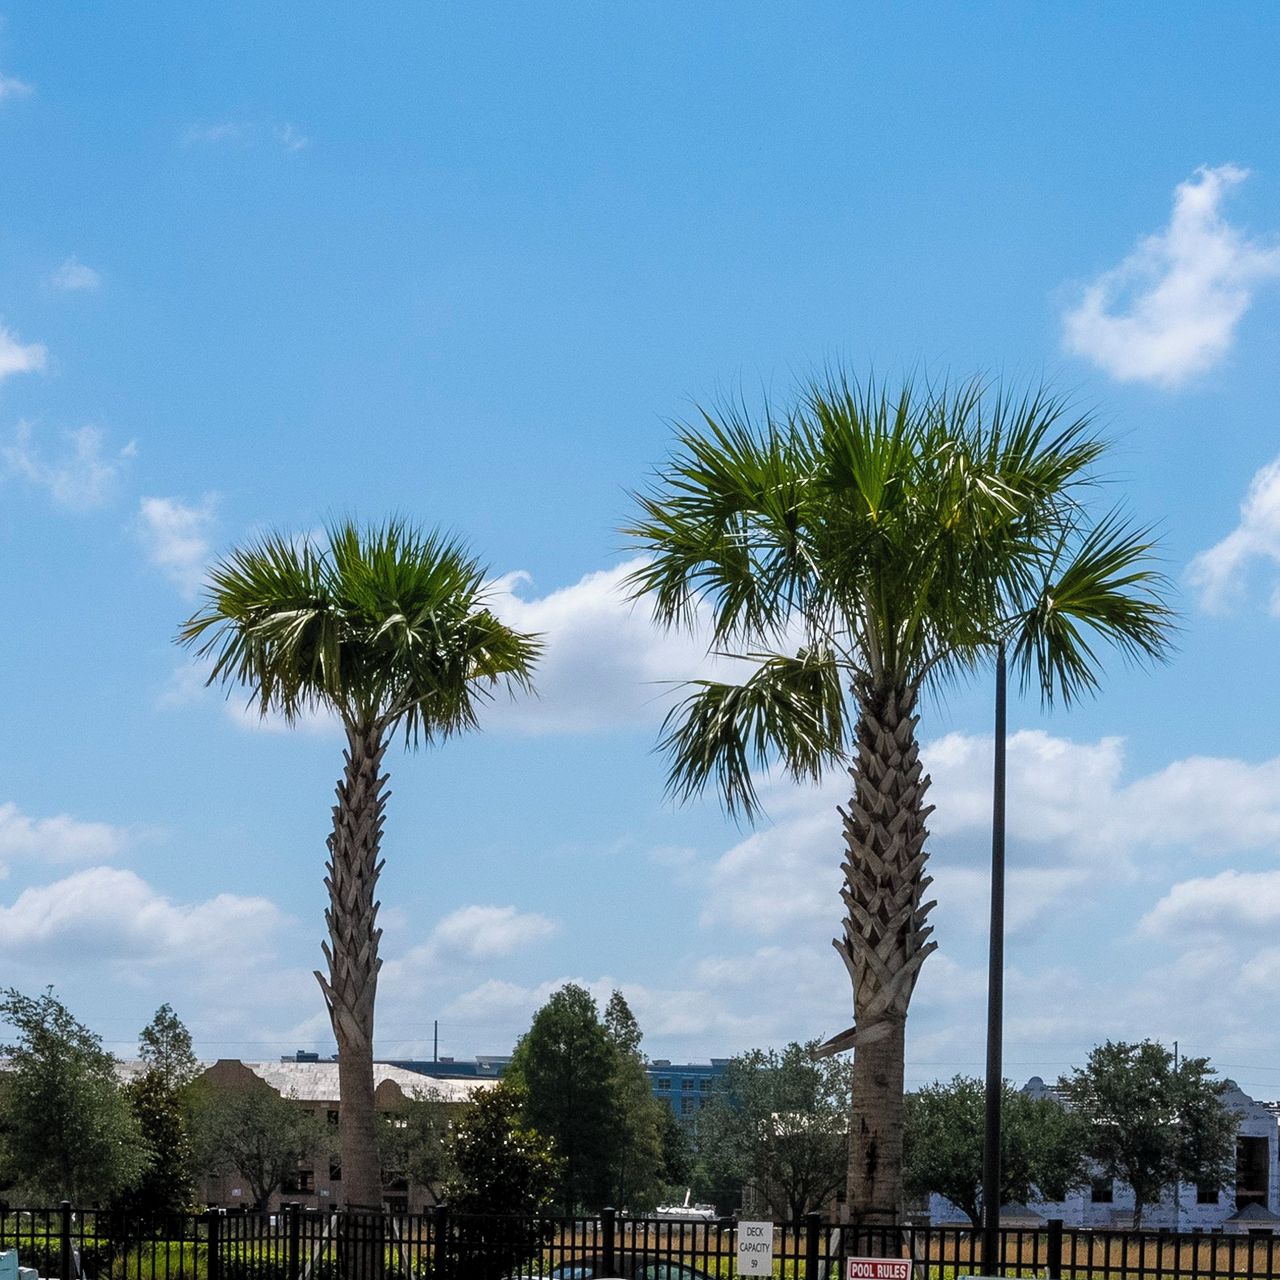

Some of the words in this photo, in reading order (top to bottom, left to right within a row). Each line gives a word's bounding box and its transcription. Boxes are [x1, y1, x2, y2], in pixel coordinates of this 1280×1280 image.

[747, 1226, 764, 1237] DECK
[740, 1242, 770, 1253] CAPACITY
[852, 1263, 874, 1278] POOL
[877, 1264, 906, 1279] RULES
